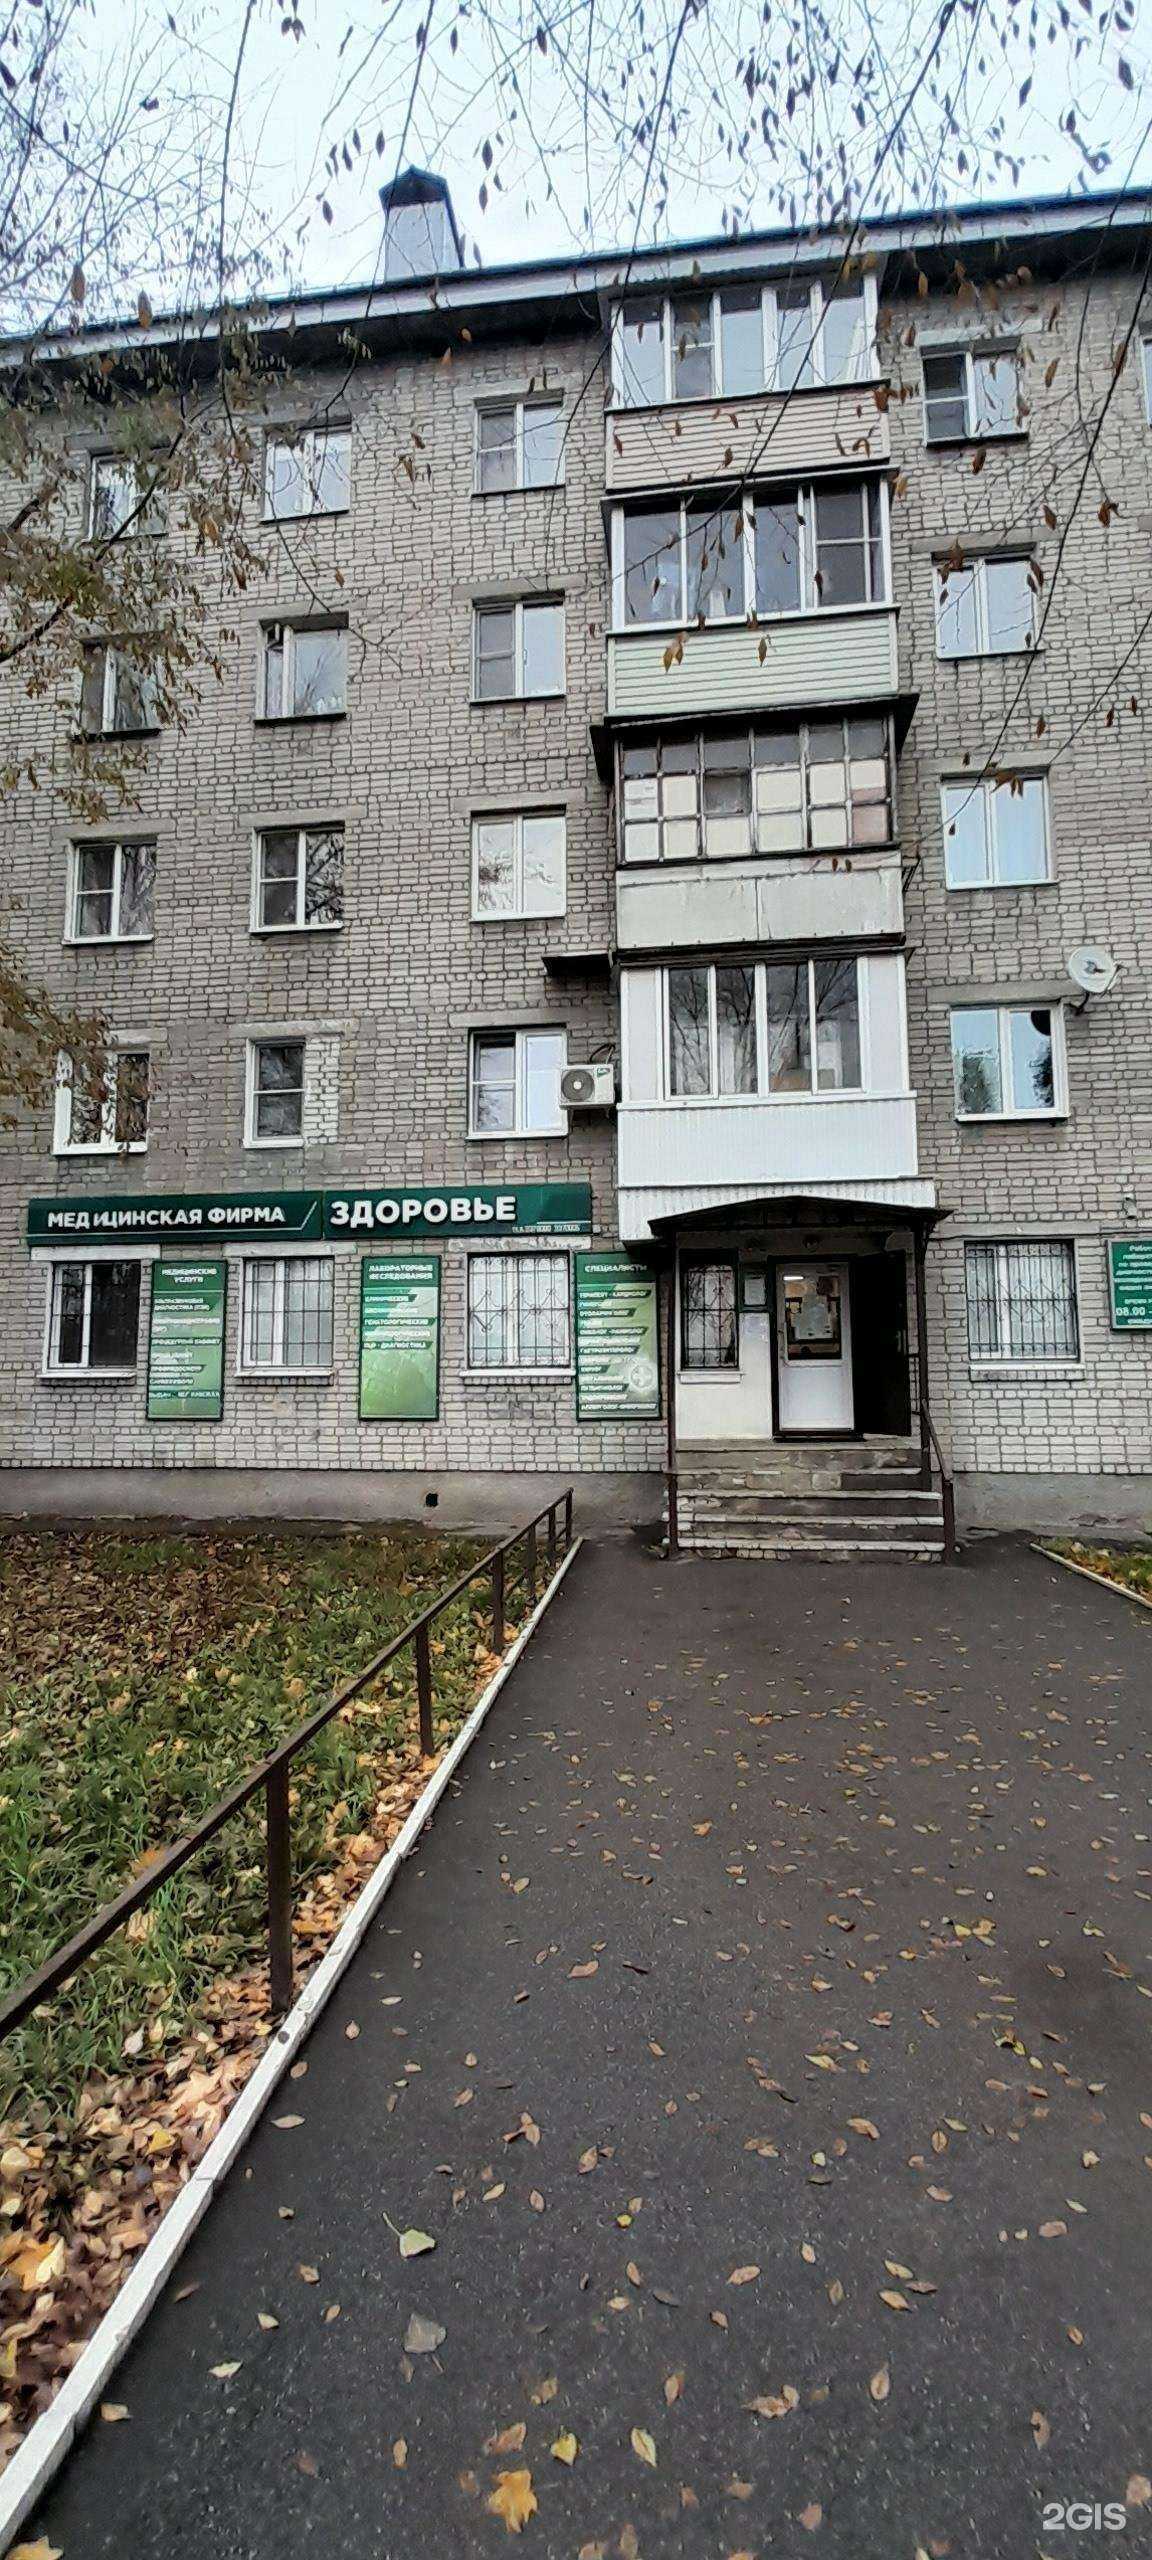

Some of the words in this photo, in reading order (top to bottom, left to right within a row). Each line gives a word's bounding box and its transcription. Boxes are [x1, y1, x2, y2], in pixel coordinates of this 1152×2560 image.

[208, 1206, 286, 1223] ФИРМА
[330, 1196, 517, 1229] ЗДОРОВЬЕ
[368, 1264, 434, 1272] ЛАБОРАТОРНЫЕ
[584, 1263, 648, 1273] СПЕЦИАЛИСТЫ
[174, 1276, 204, 1284] УСЛУГИ
[368, 1273, 434, 1281] ИССЛЕДОВАНИЯ
[1115, 1306, 1146, 1316] 08.00
